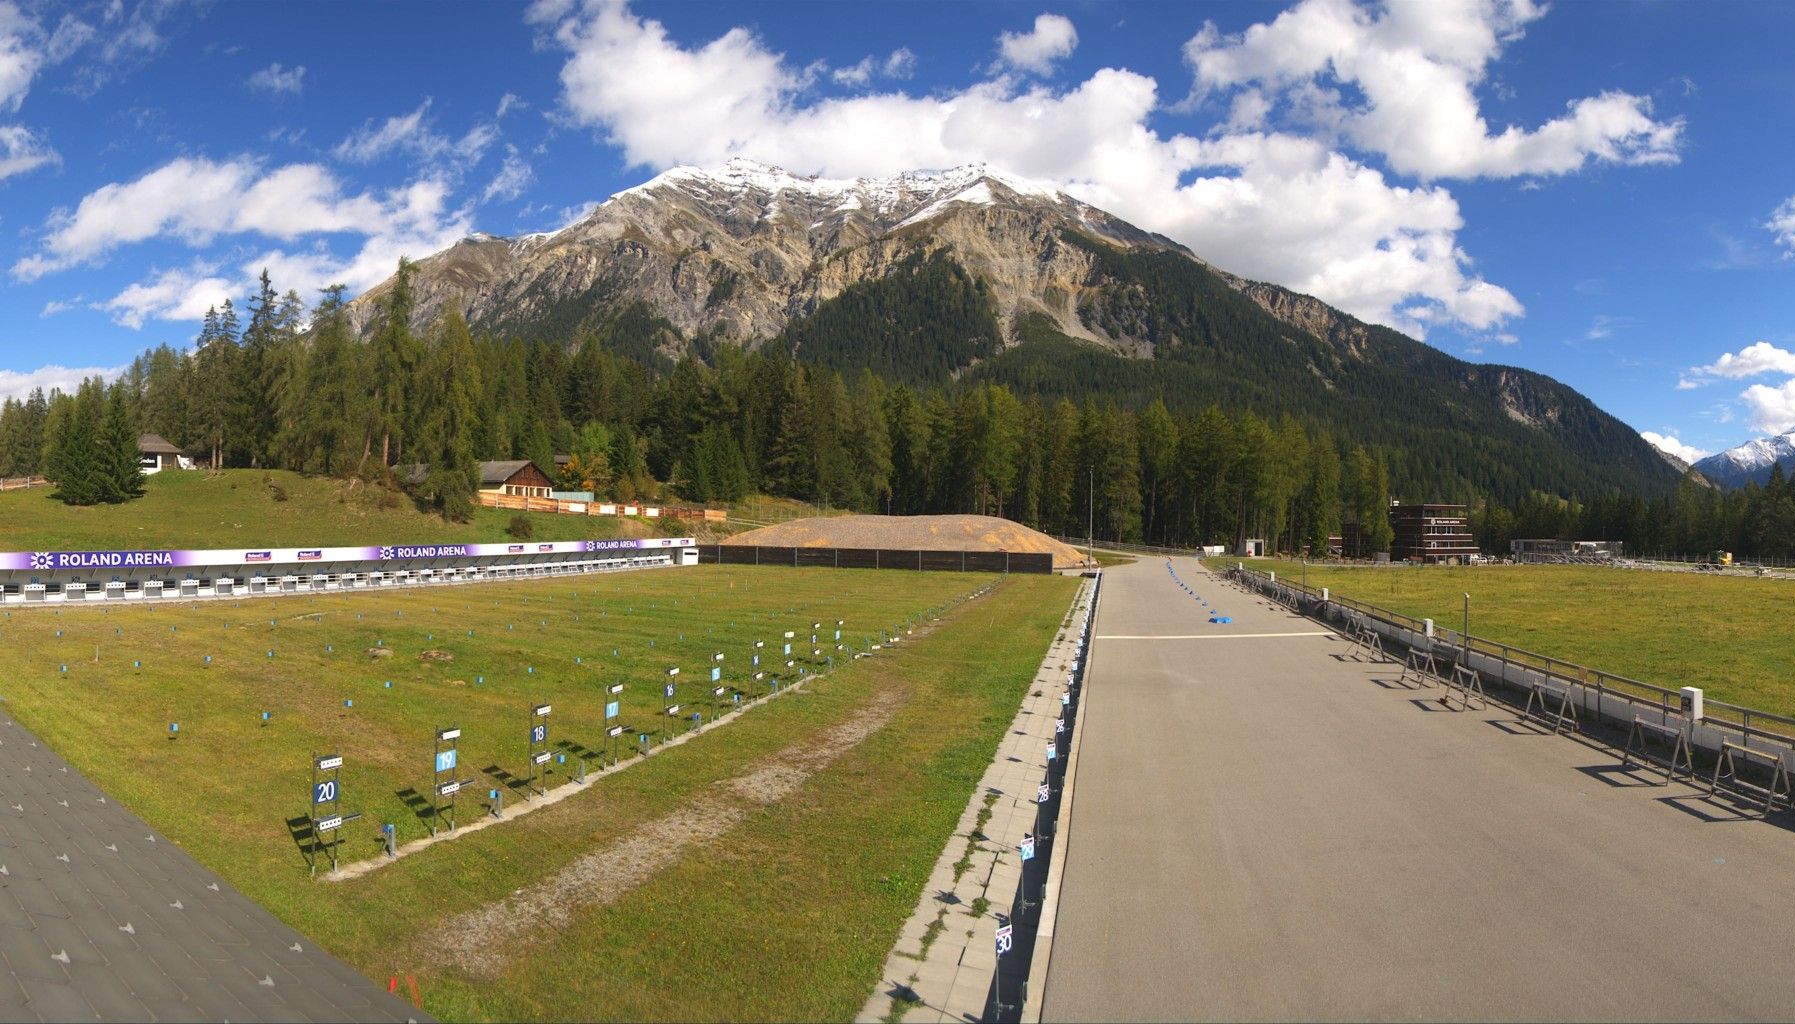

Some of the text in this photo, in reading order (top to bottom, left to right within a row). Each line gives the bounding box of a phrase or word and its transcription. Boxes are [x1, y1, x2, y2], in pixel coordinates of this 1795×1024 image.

[398, 546, 467, 558] ROLAND ARENA
[596, 540, 637, 550] ROLAND ARENA
[59, 552, 173, 566] ROLAND ARENA
[666, 685, 674, 697] 16
[533, 725, 544, 741] 18
[440, 752, 452, 769] 19
[317, 782, 335, 803] 20
[1022, 845, 1033, 860] 29
[996, 934, 1012, 954] 30
